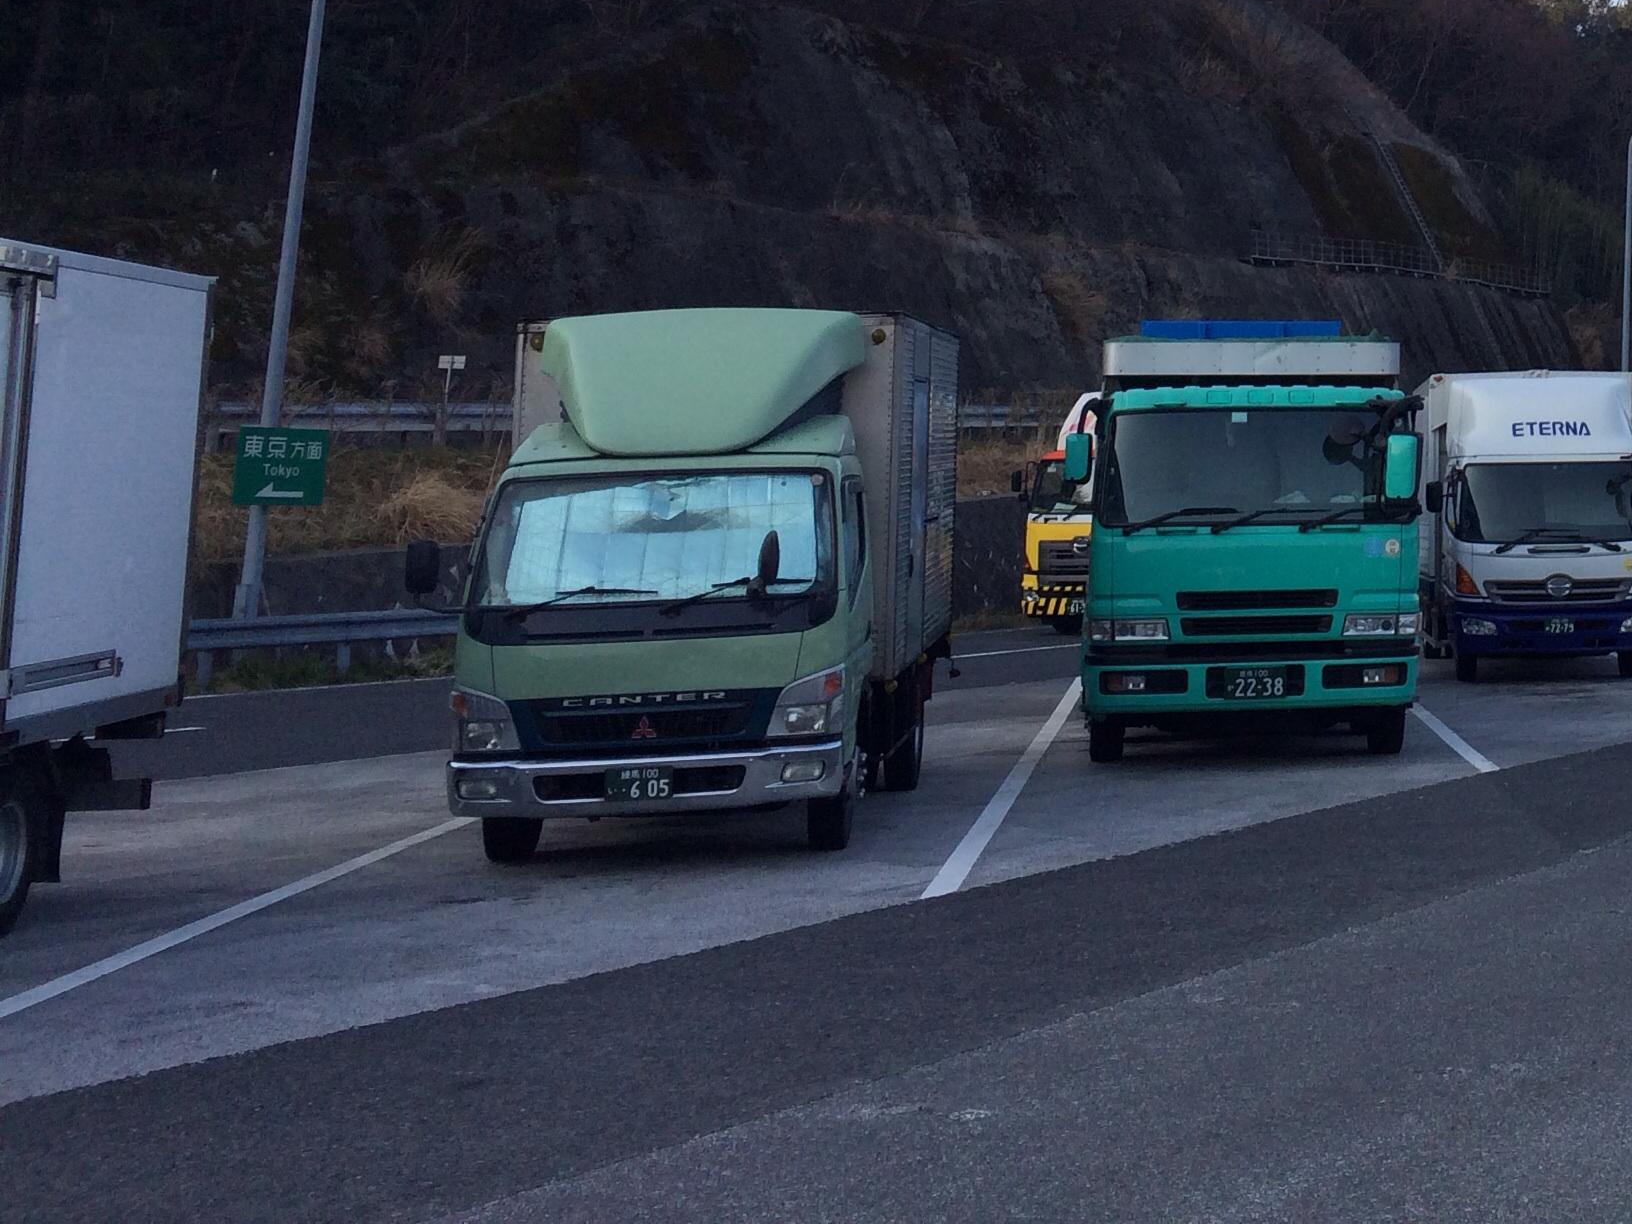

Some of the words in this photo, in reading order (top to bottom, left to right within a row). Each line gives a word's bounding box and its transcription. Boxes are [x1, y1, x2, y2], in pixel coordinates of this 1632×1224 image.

[1511, 421, 1592, 437] ETERNA
[243, 435, 323, 460] 東京方面
[262, 463, 300, 479] Tokyo
[1234, 677, 1284, 697] 22-38
[562, 691, 726, 707] CANTER
